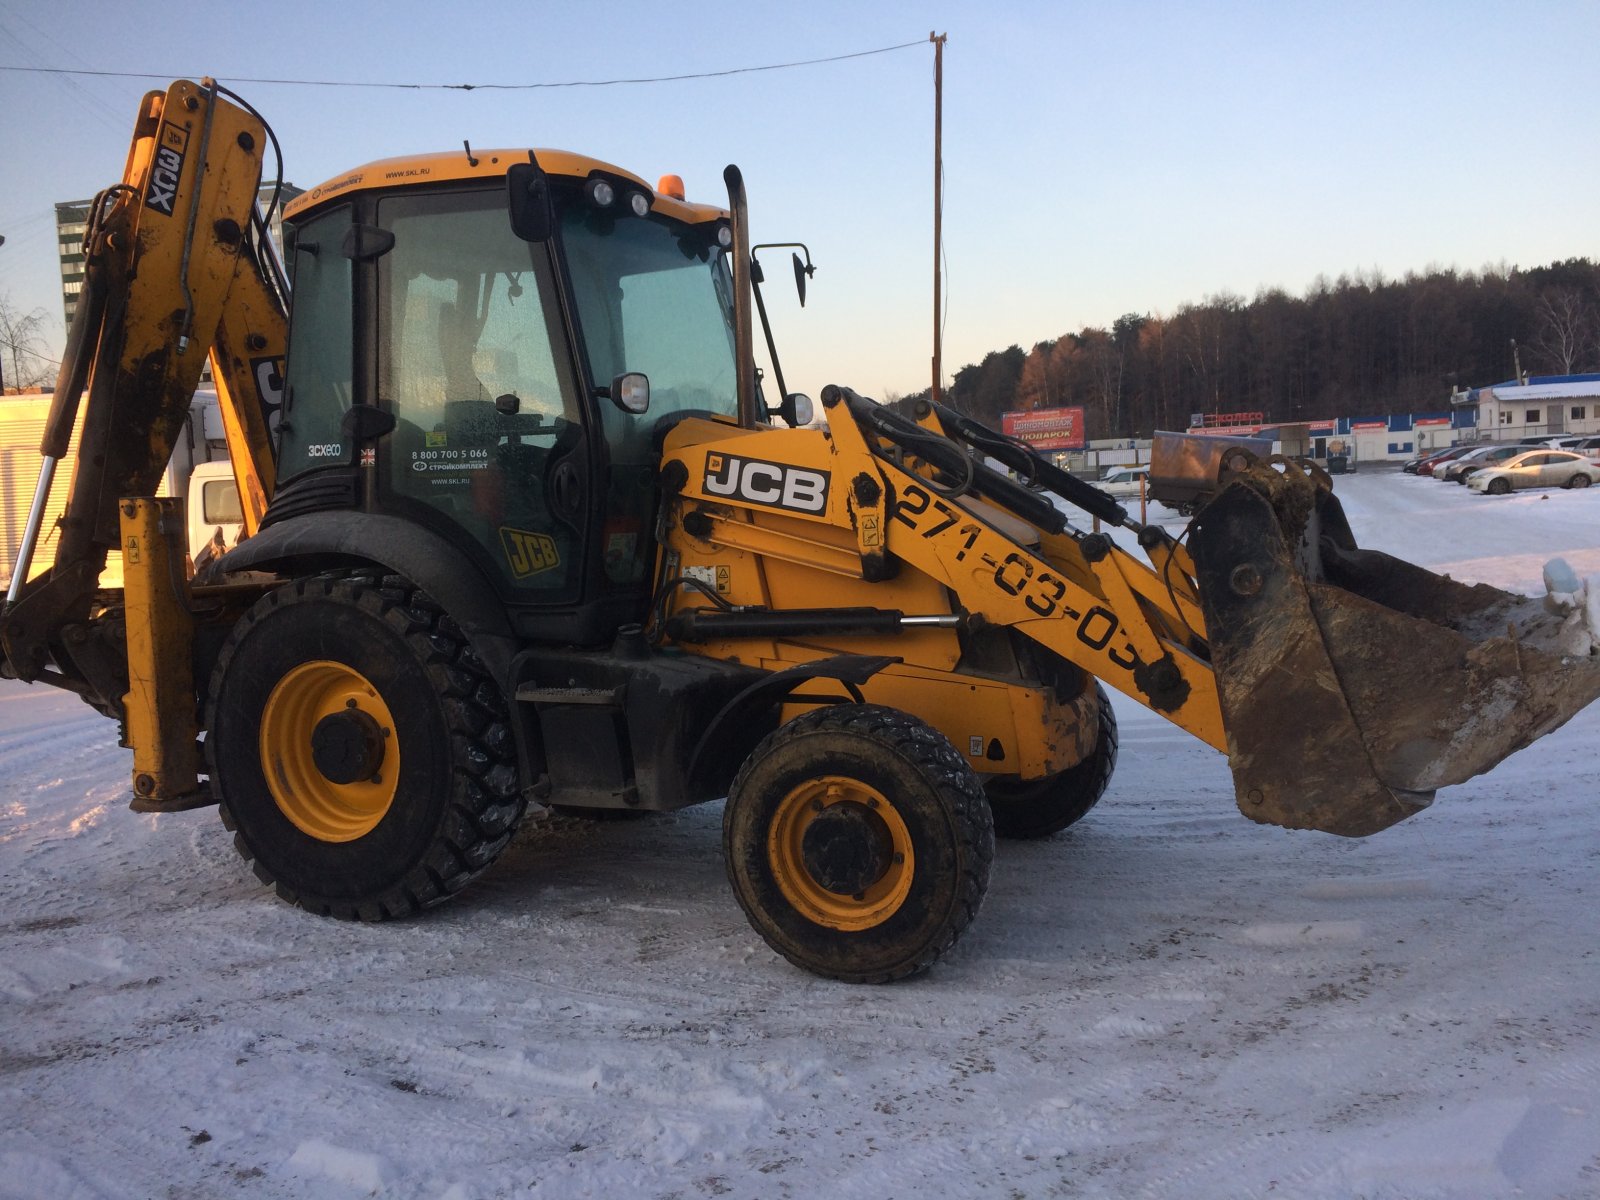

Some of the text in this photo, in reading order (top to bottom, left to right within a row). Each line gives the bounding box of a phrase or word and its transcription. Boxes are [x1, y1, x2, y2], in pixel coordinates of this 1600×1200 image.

[385, 168, 430, 179] WWW.SKL.RU
[148, 148, 181, 212] 3CX
[1014, 418, 1073, 430] ШИНОМОНТАЖ
[1021, 430, 1071, 440] ПОДАРОК
[308, 443, 341, 457] 3CXeco
[412, 449, 488, 460] 8 800 700 5 066
[429, 463, 488, 471] СТРОЙКОМПЛЕКТ
[706, 458, 826, 512] JCB
[510, 533, 556, 574] JCB
